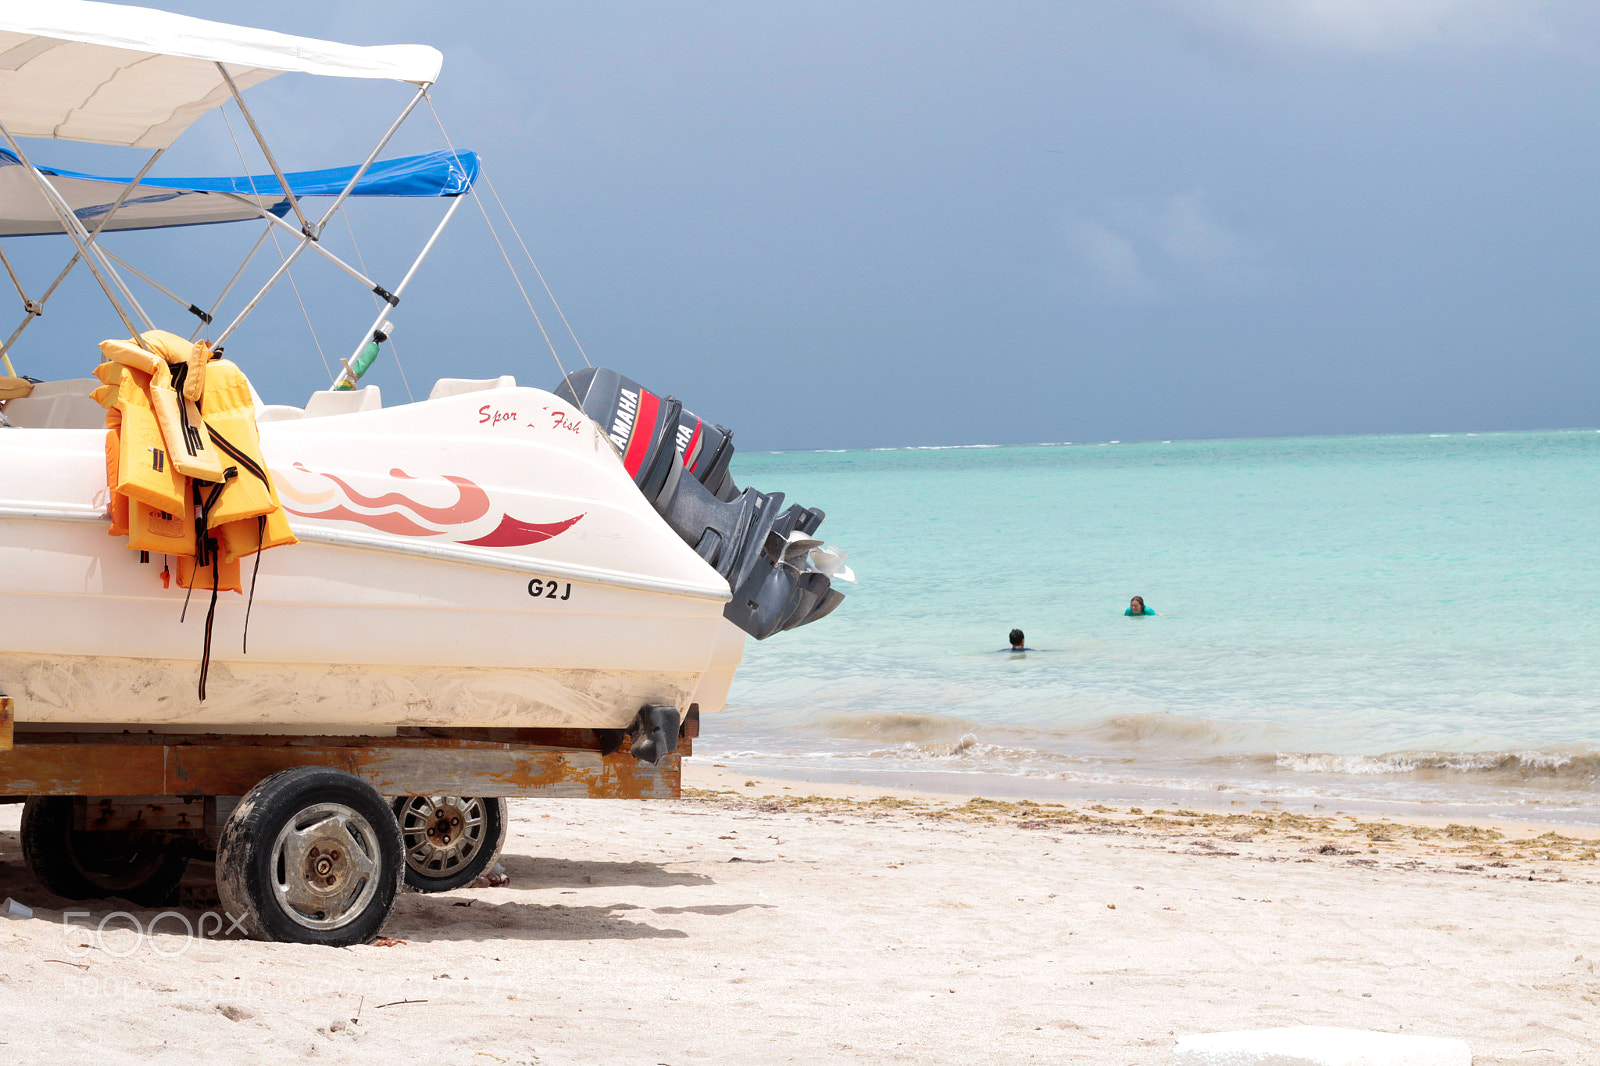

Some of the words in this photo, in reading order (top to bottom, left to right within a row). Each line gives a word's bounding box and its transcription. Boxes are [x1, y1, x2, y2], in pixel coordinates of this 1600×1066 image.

[551, 411, 581, 434] Fish
[609, 388, 638, 456] AMAHA
[528, 579, 571, 600] G2J
